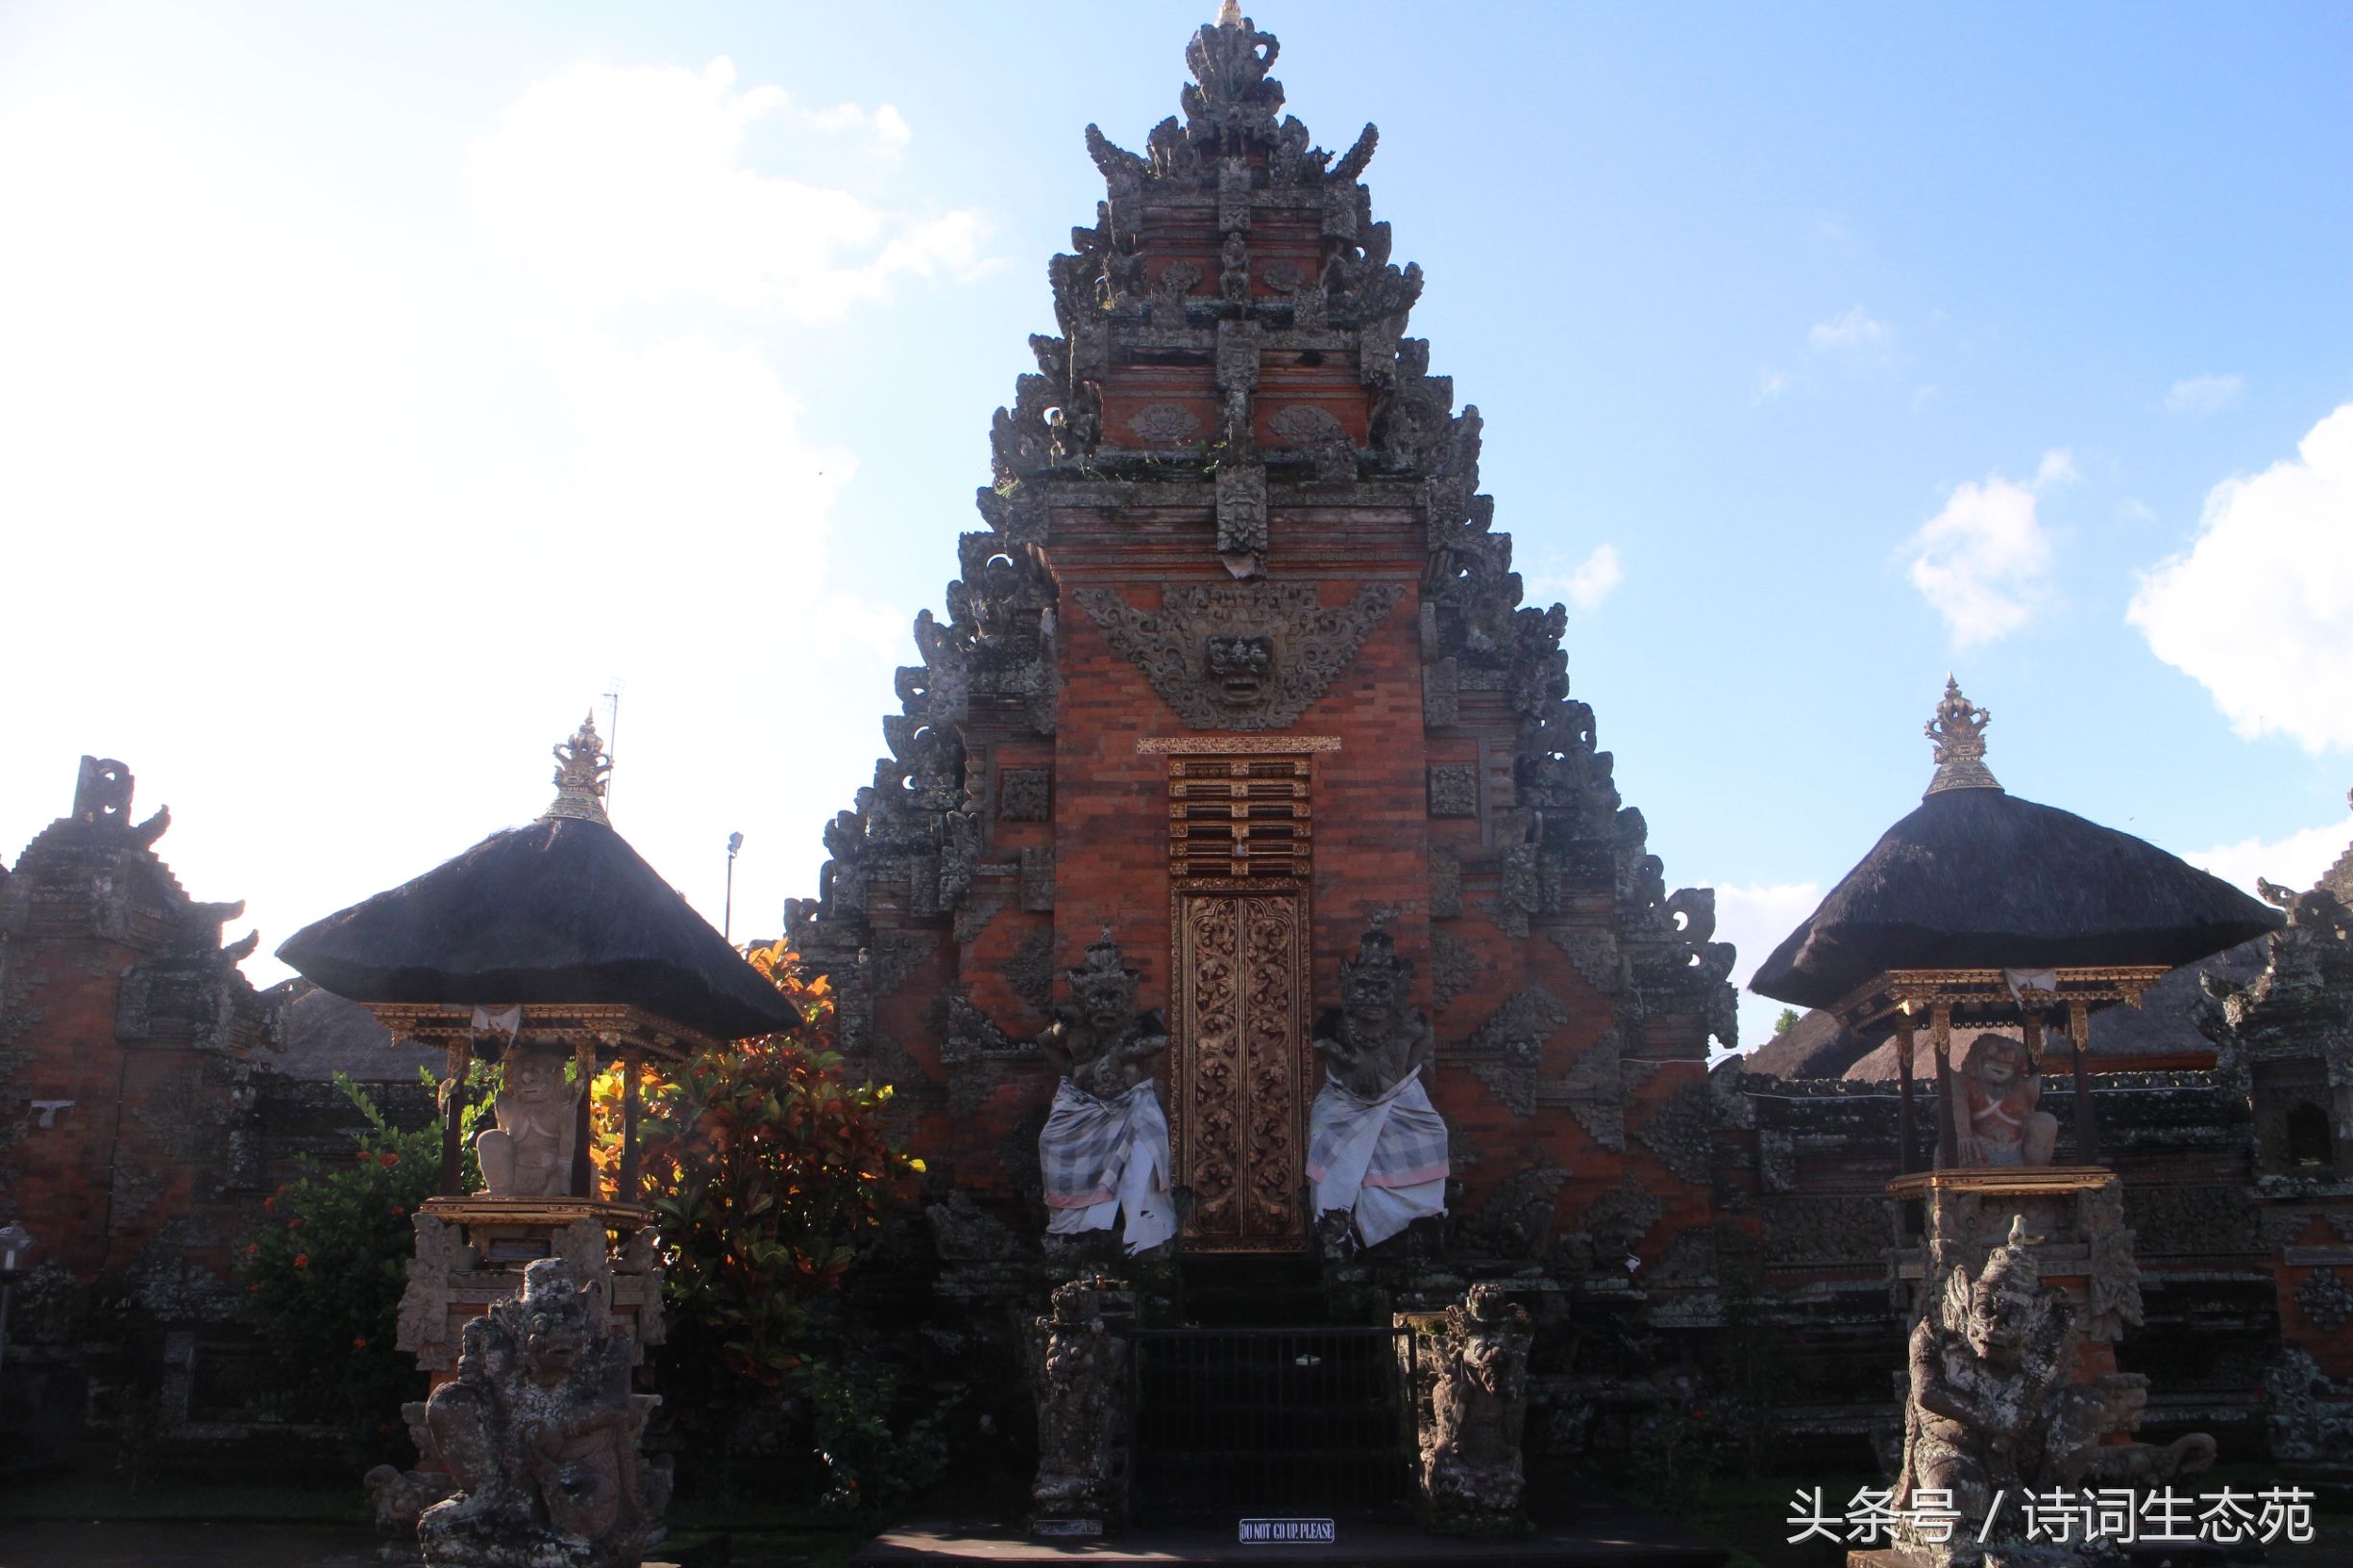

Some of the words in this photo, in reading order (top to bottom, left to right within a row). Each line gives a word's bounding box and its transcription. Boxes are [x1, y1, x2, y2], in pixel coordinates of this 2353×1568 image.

[1241, 1523, 1253, 1539] DO
[1254, 1523, 1270, 1539] NOT
[1273, 1523, 1286, 1539] GO
[1300, 1522, 1333, 1539] PLEASE
